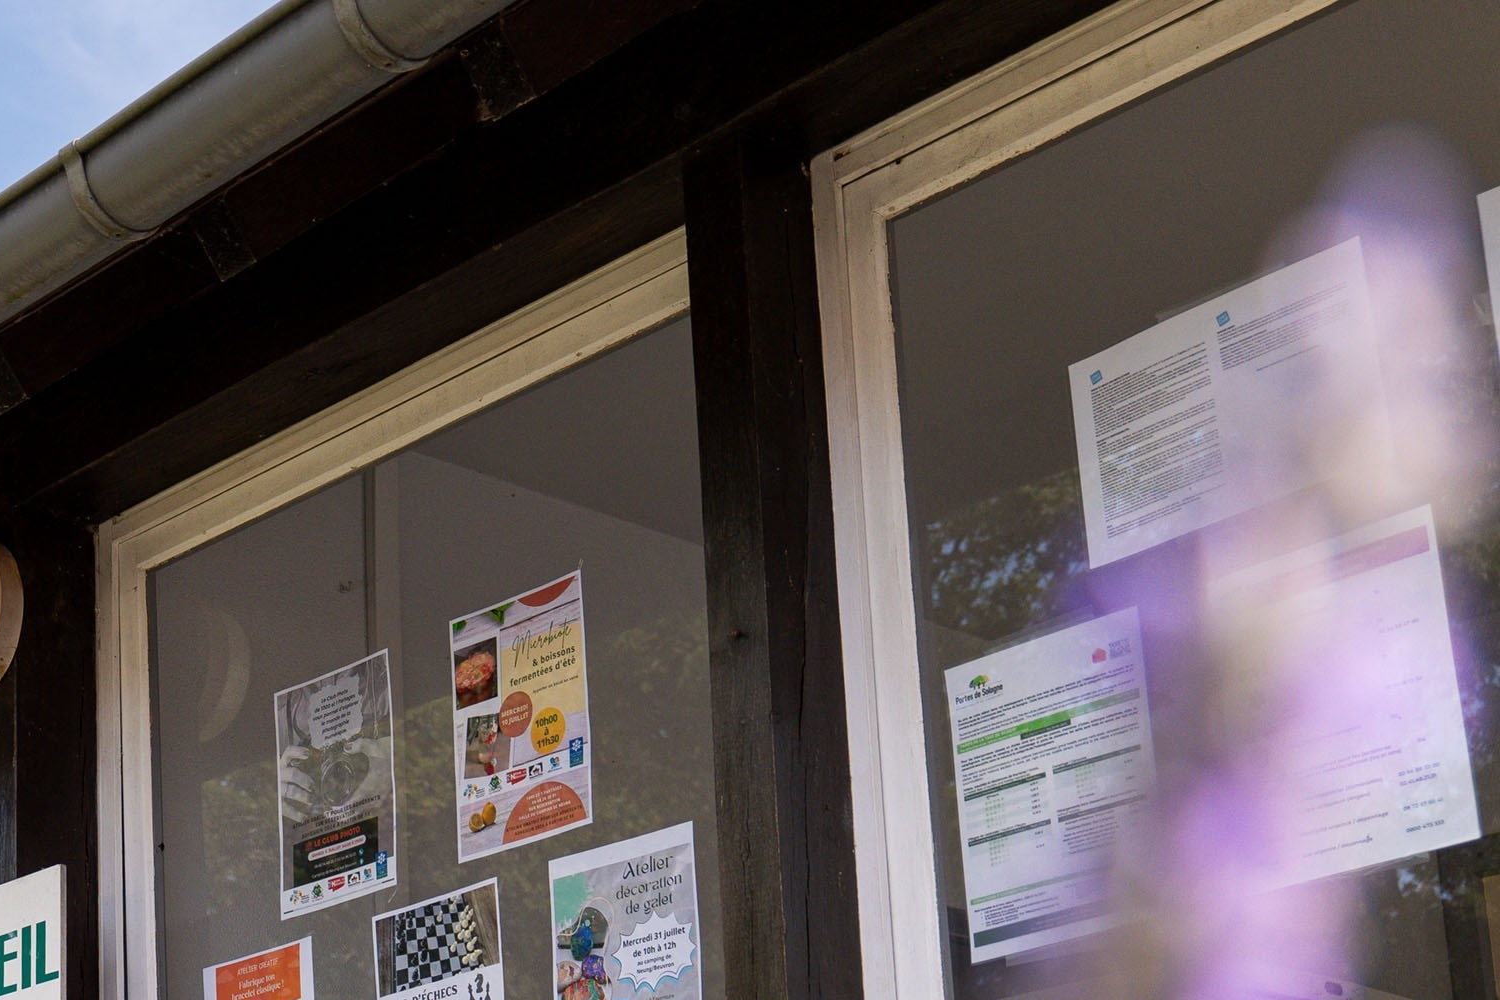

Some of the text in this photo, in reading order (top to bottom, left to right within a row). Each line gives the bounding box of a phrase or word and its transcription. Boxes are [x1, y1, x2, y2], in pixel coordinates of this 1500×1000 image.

[511, 618, 578, 668] Microbiote
[532, 645, 575, 666] & boissons
[509, 655, 576, 686] fermentées d'été
[955, 692, 973, 705] Portes
[974, 691, 981, 699] de
[981, 683, 1003, 698] Sologne
[501, 703, 528, 717] MERCREDI
[508, 711, 529, 725] JUILLET
[535, 713, 557, 727] 10h00
[544, 726, 548, 735] à
[536, 734, 559, 748] 11h30
[313, 825, 360, 847] LE CLUB PHOTO
[622, 855, 673, 879] Atelier
[615, 873, 682, 899] décoration
[625, 892, 673, 914] de galet
[622, 926, 685, 947] Mercredi 31 juillet
[632, 949, 641, 957] de
[643, 945, 655, 954] 10h
[663, 940, 676, 950] 12h
[643, 955, 663, 964] camping
[237, 964, 257, 974] ATELIER
[238, 973, 275, 989] Fabrique ton
[231, 989, 255, 1000] bracelet
